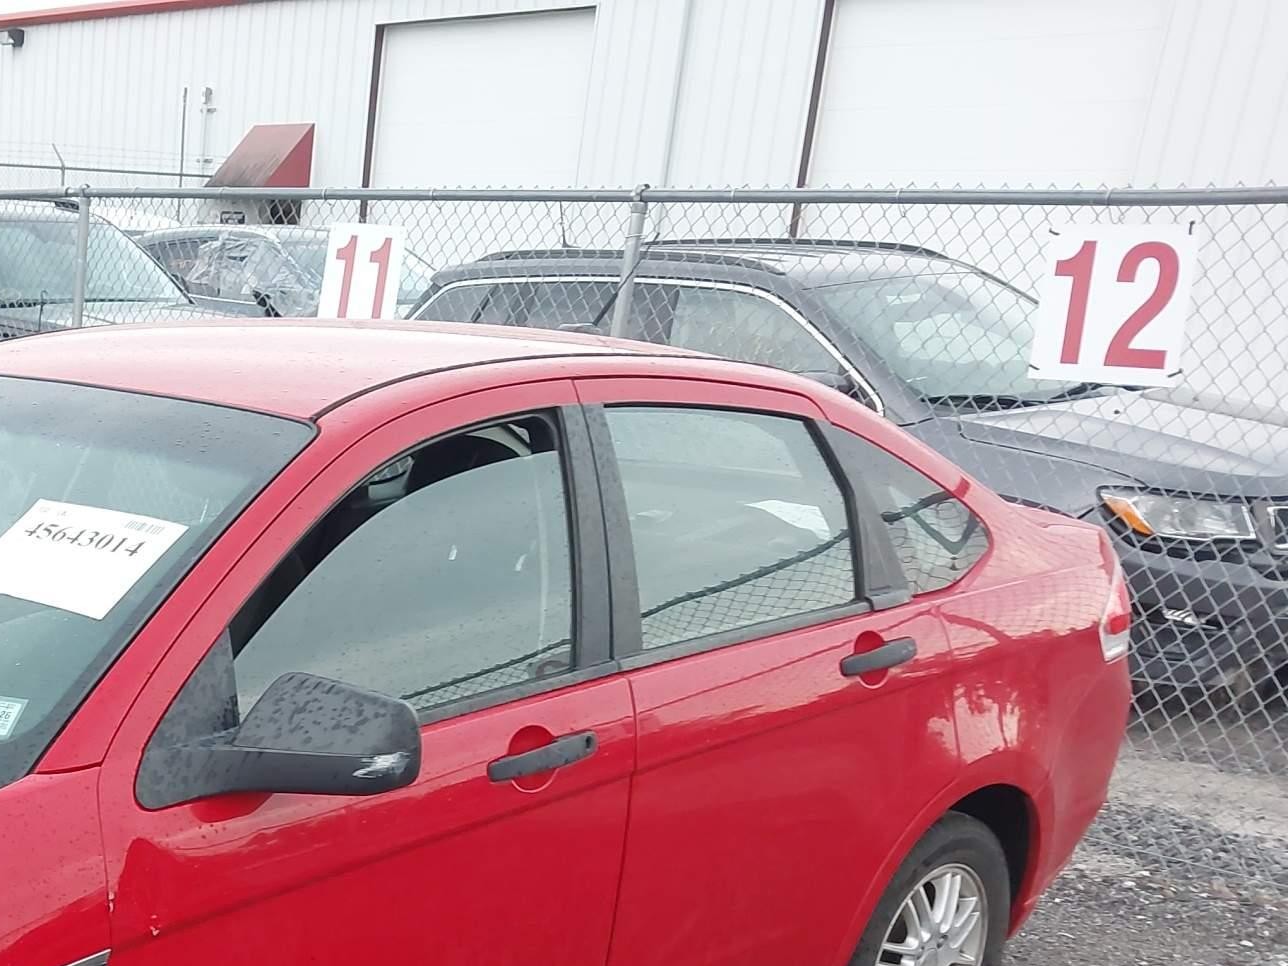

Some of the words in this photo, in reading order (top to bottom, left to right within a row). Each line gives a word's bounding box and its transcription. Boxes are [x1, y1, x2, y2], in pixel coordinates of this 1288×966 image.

[335, 234, 393, 320] 11
[1052, 238, 1184, 371] 12
[24, 522, 147, 557] 45643014
